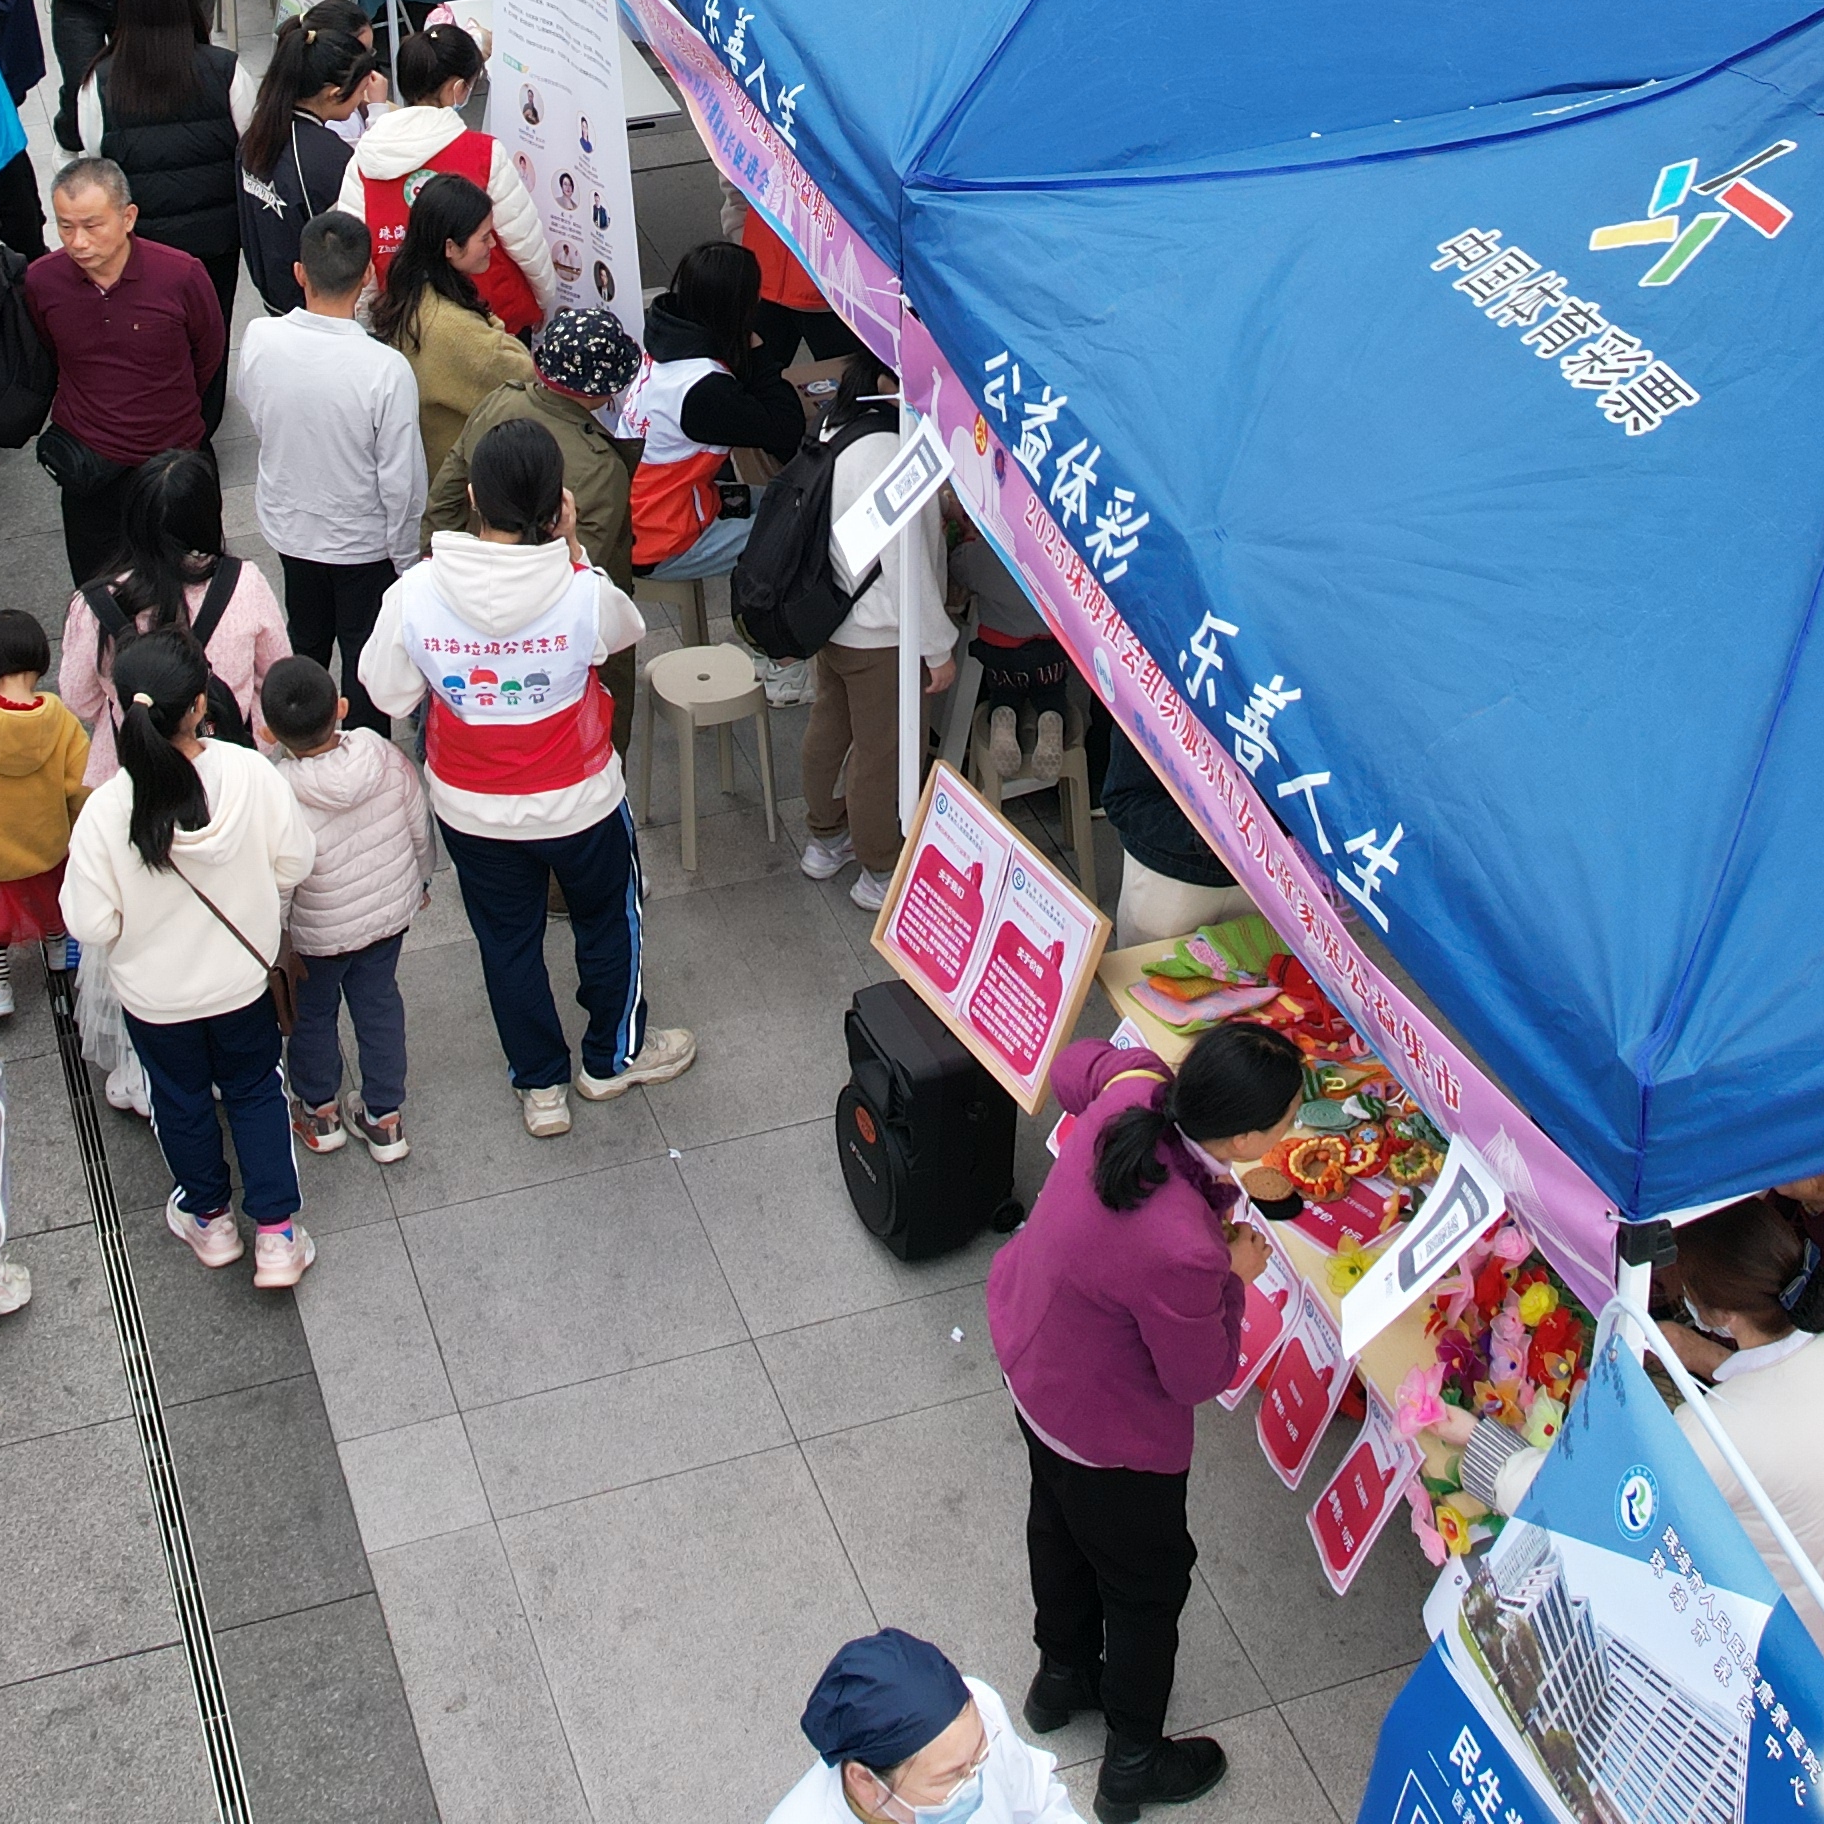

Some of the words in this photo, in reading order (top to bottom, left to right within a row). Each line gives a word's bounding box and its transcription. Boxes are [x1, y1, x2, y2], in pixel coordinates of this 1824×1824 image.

[1428, 226, 1702, 438] 中国体育彩票
[981, 346, 1151, 584] 公益体彩
[1178, 609, 1404, 934] 乐善人生
[1023, 494, 1463, 1114] 2025珠海社会组织服务妇女儿童家庭公益集市
